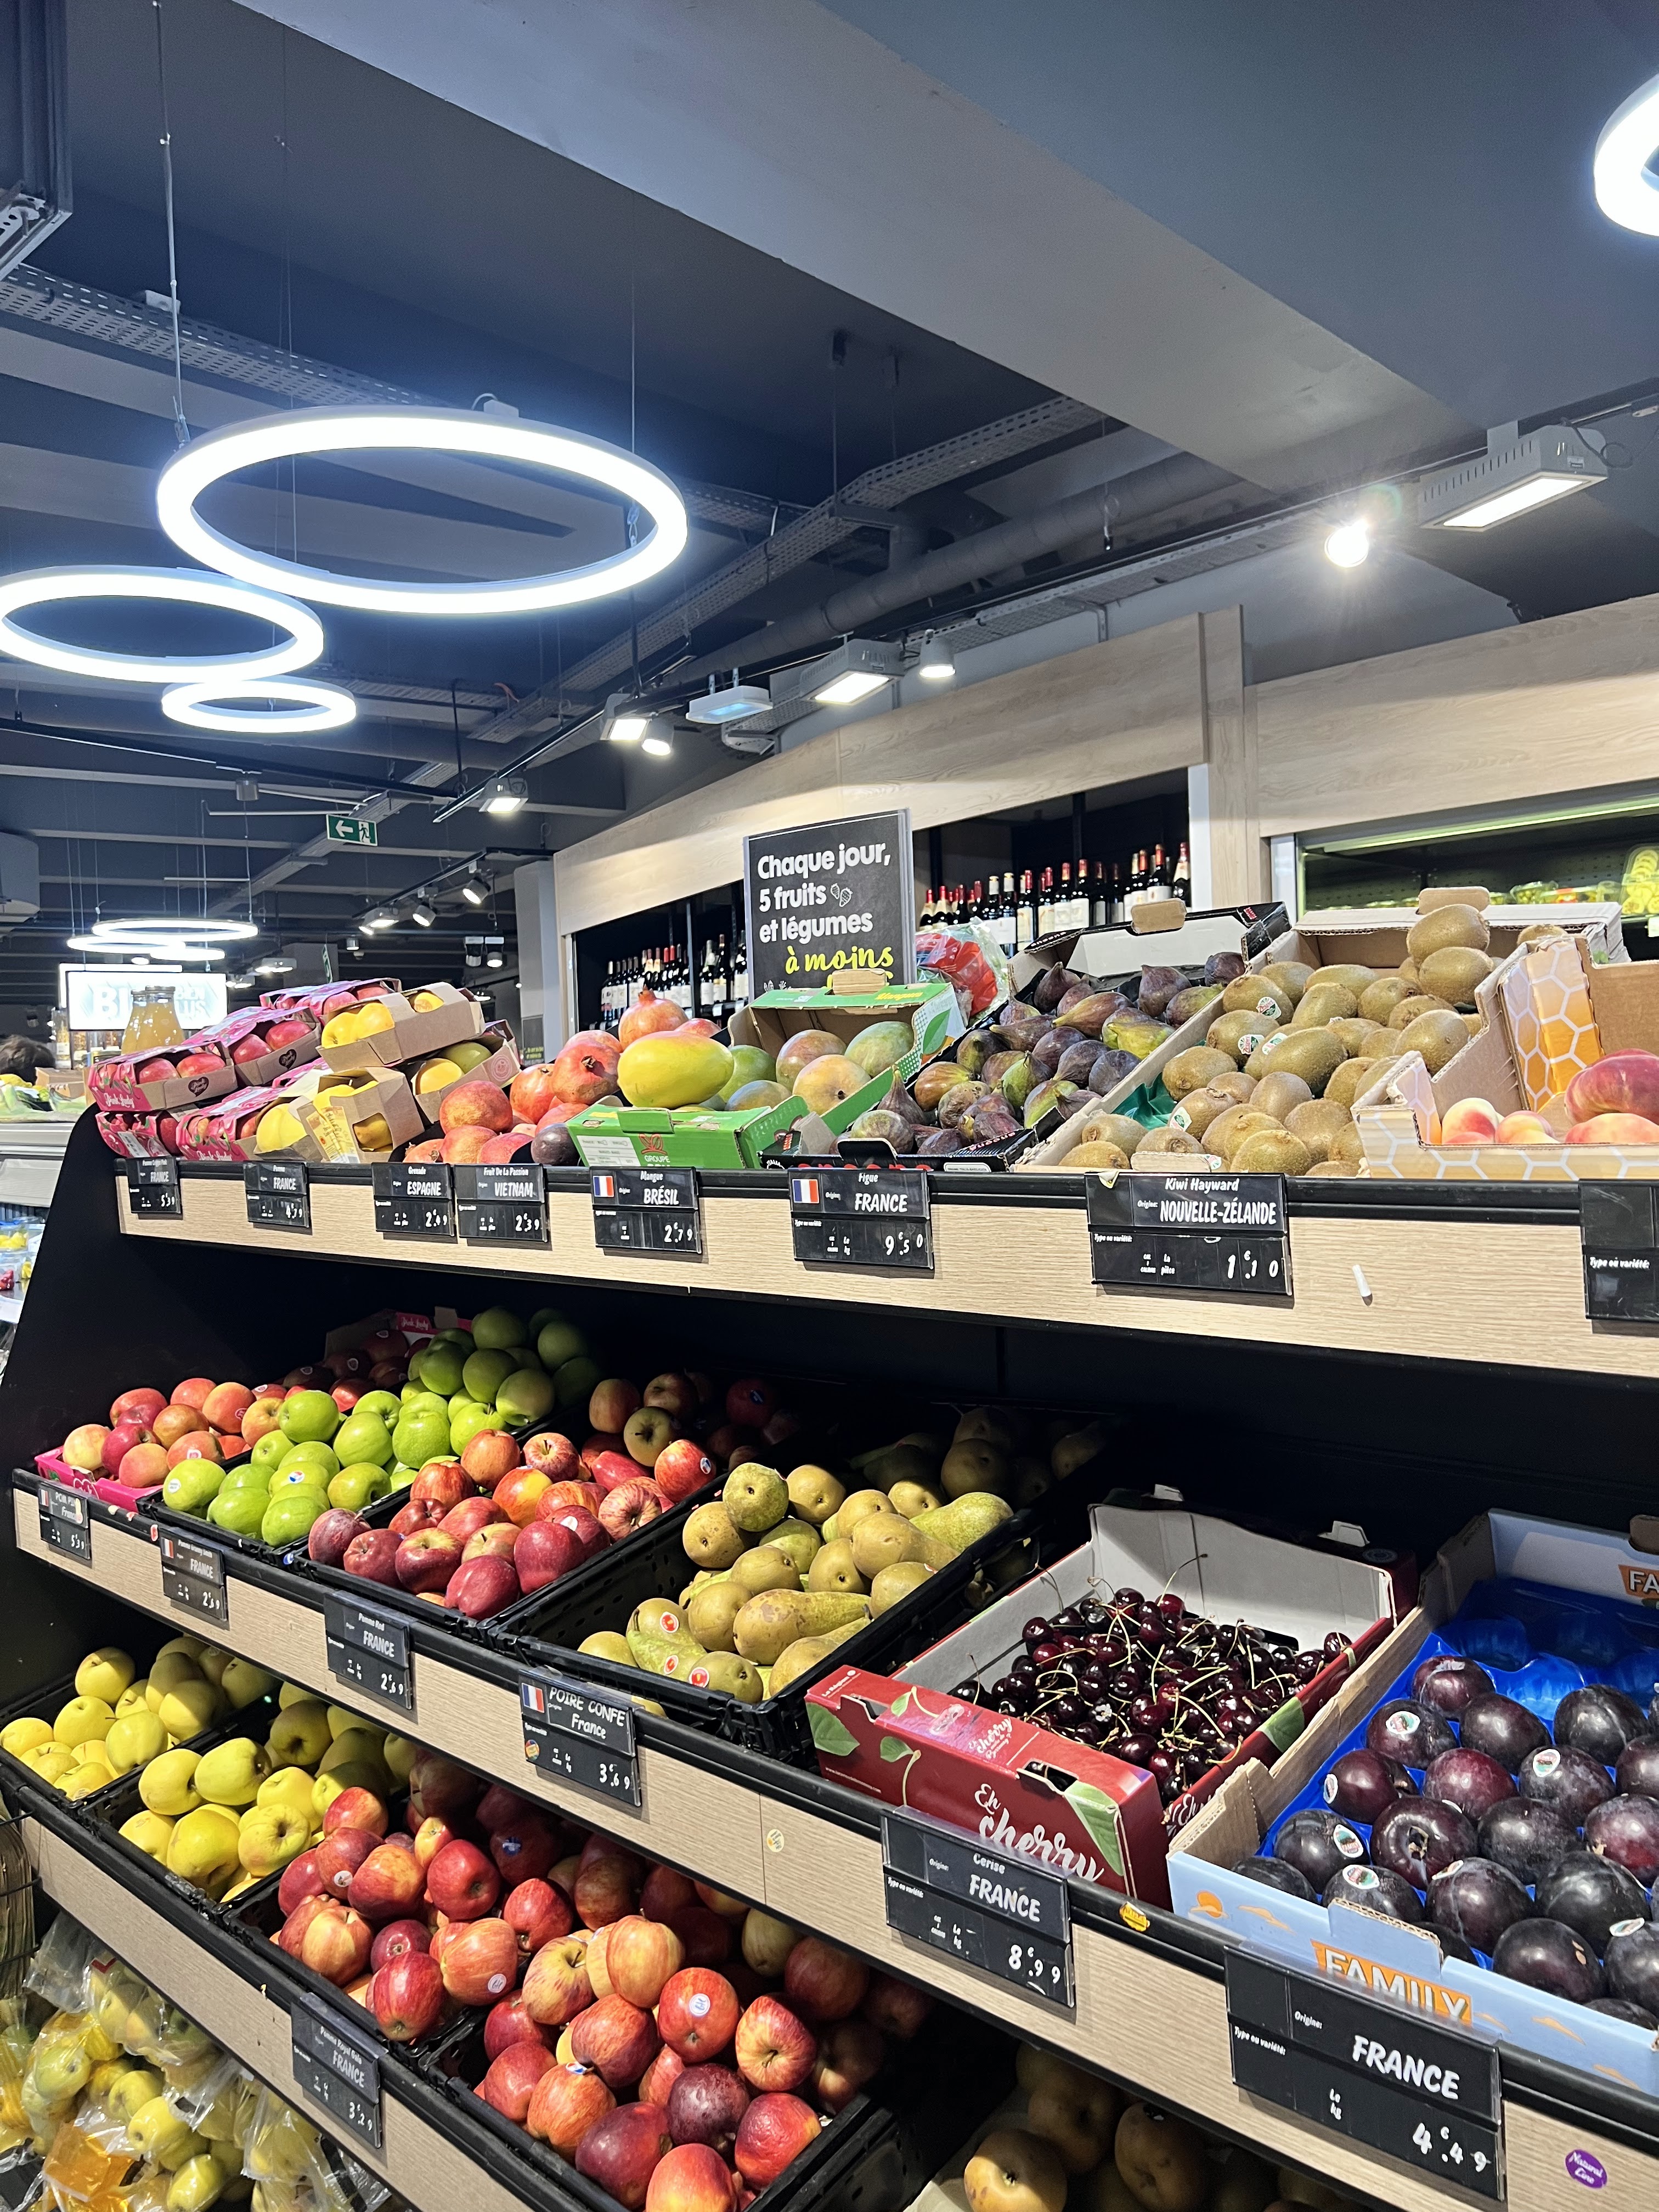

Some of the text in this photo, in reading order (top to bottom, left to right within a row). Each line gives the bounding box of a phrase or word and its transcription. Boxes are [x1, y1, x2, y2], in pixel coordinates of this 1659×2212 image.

[757, 843, 891, 879] Chaque jour,
[759, 882, 827, 912] 5 fruits
[759, 912, 873, 944] et légumes
[786, 945, 894, 974] à moins
[150, 1171, 169, 1182] FRANCE
[484, 1167, 529, 1176] Fruit De La Passion
[640, 1171, 663, 1183] Mangue
[859, 1173, 878, 1185] Figue
[273, 1177, 296, 1190] FRANCE
[407, 1181, 442, 1196] ESPAGNE
[494, 1182, 534, 1198] VIETNAM
[1165, 1178, 1239, 1194] Kiwi Hayward
[644, 1186, 679, 1205] BRÉSIL
[855, 1193, 908, 1212] FRANCE
[1160, 1197, 1277, 1225] NOUVELLE-ZÉLANDE
[1590, 1257, 1607, 1269] Type
[190, 1558, 213, 1579] FRANCE
[363, 1630, 394, 1657] FRANCE
[549, 1686, 626, 1727] POIRE CONFE
[572, 1713, 606, 1739] France
[974, 1783, 1002, 1816] Eh
[973, 1853, 1006, 1874] Cerise
[969, 1874, 1040, 1922] FRANCE
[1294, 2010, 1323, 2030] Origine:
[1234, 2025, 1250, 2041] Type
[332, 2050, 365, 2088] FRANCE
[1352, 2035, 1460, 2100] FRANCE
[1329, 2089, 1340, 2103] Le
[1330, 2103, 1342, 2120] kg
[1568, 2152, 1603, 2178] Natural
